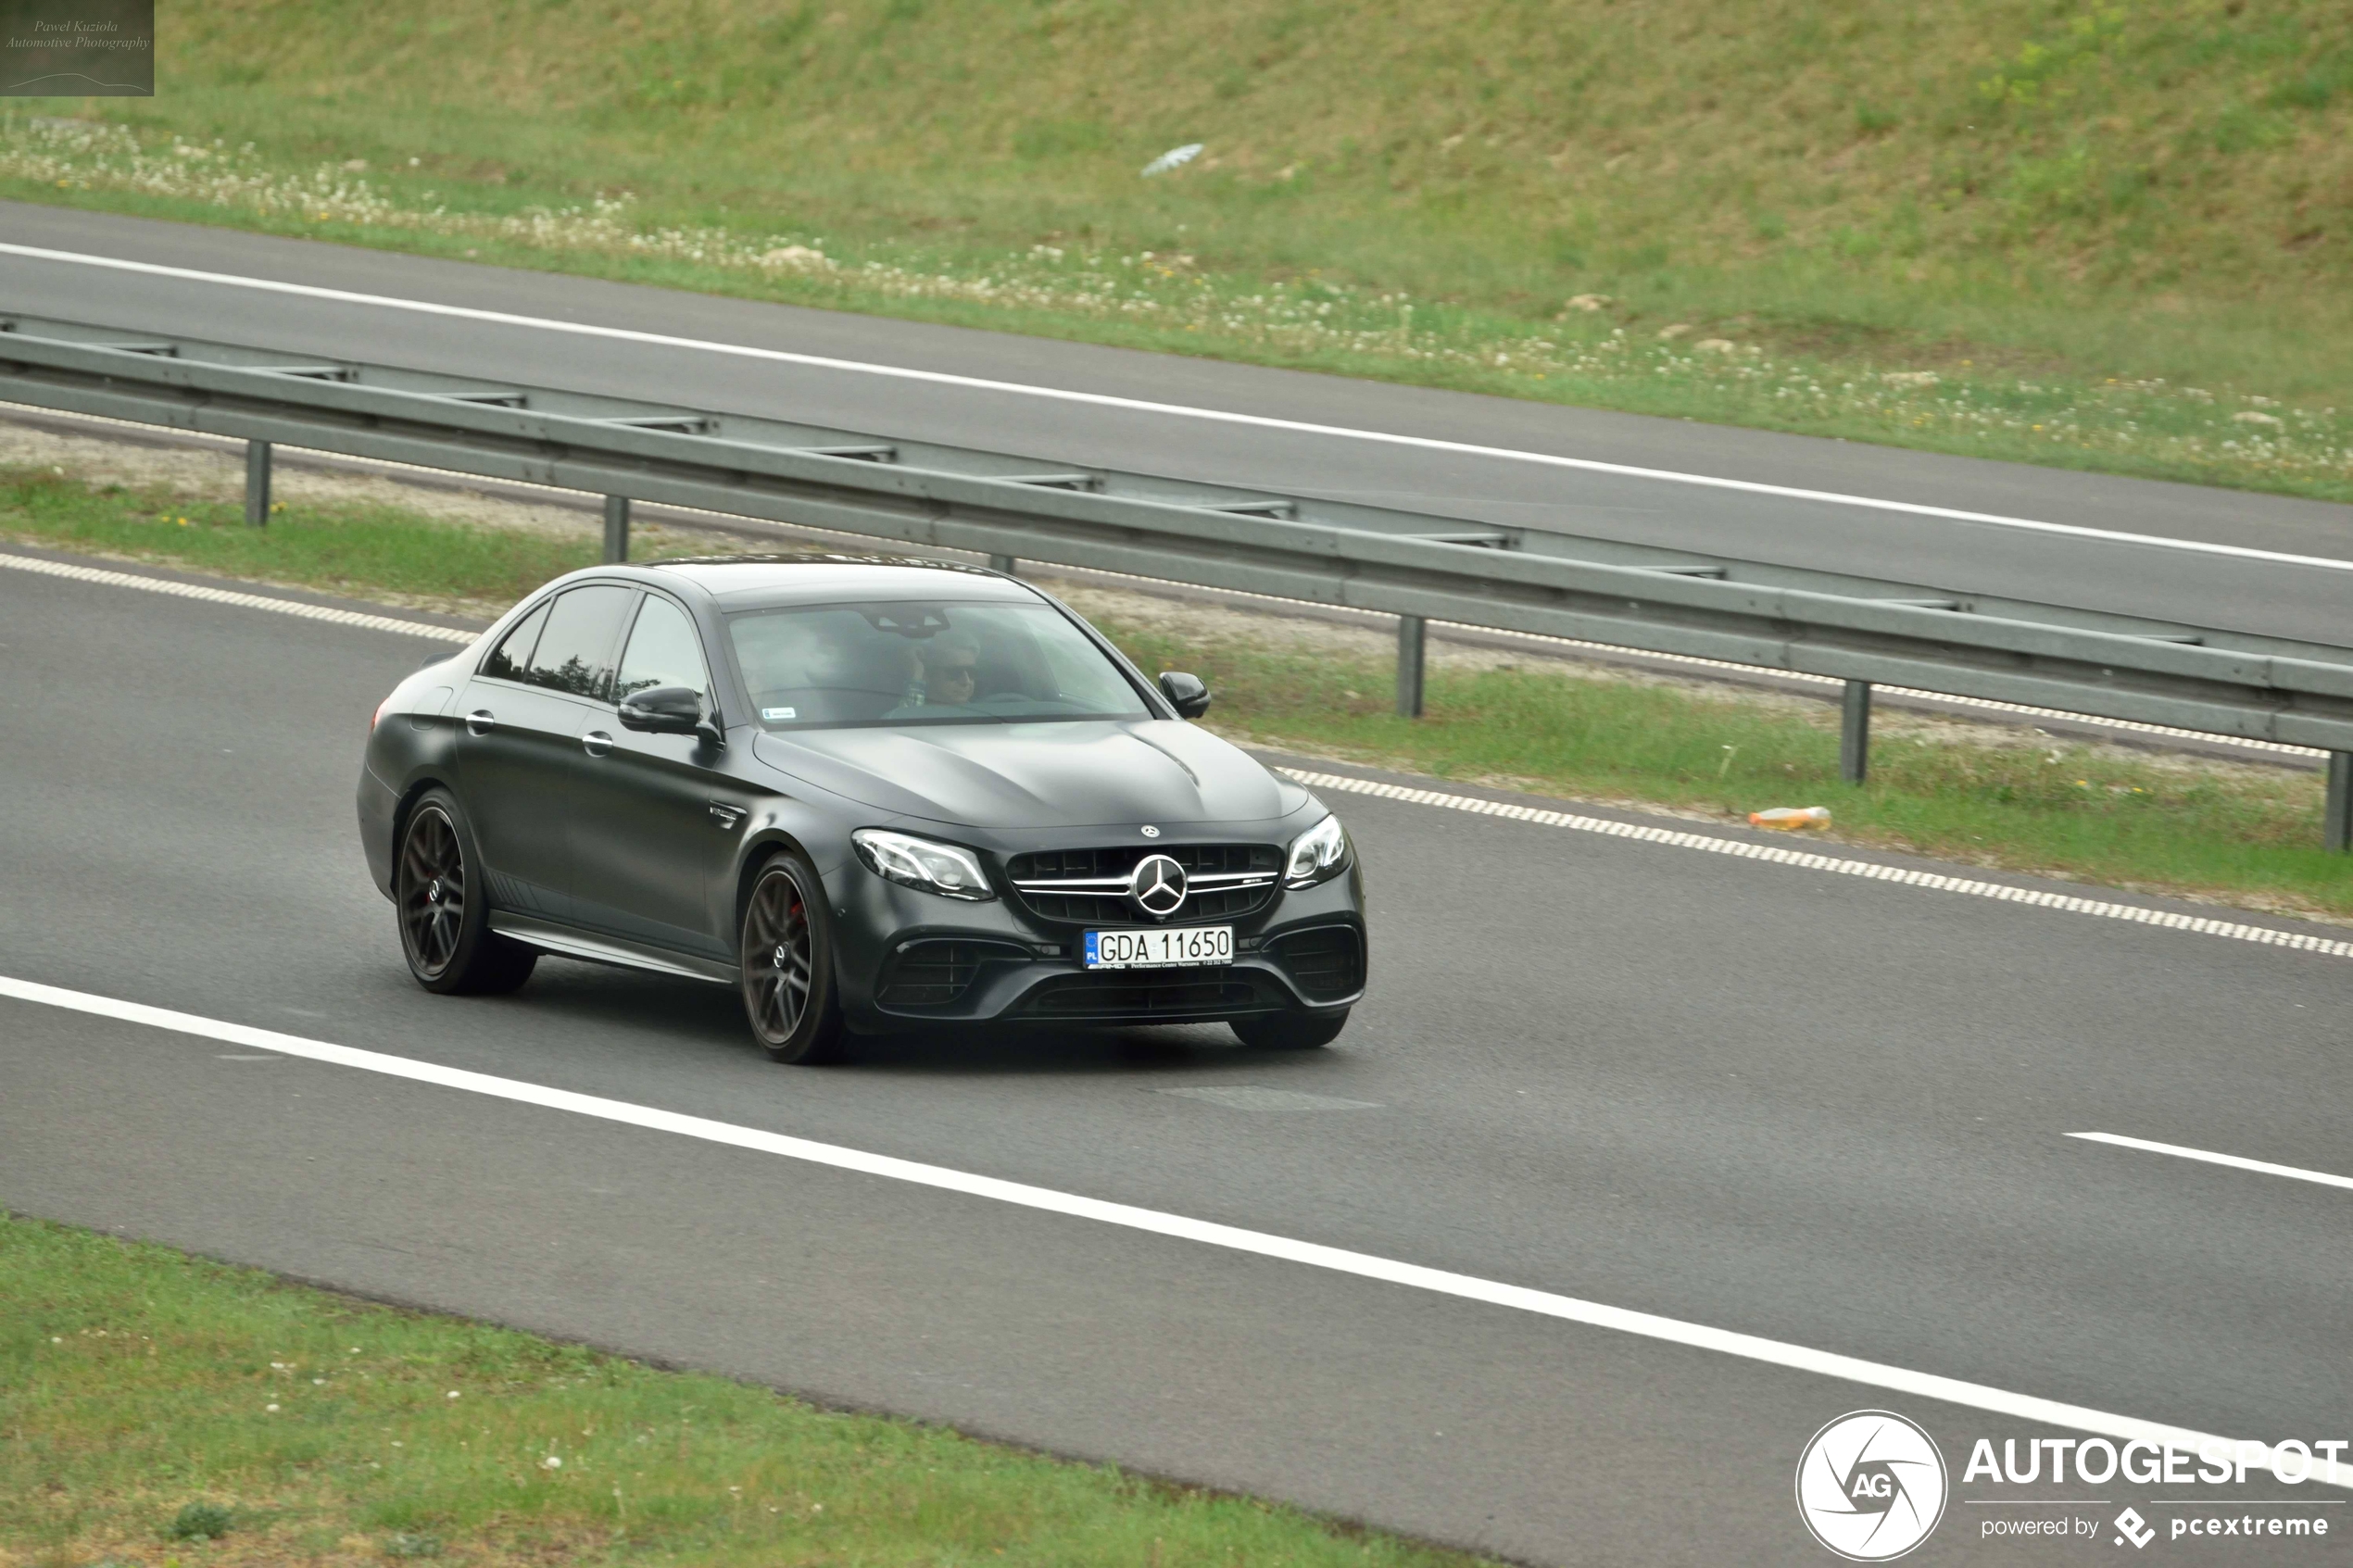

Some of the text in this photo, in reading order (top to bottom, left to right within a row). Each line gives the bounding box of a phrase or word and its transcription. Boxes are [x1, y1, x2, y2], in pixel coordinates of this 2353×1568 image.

[1087, 951, 1097, 960] PL
[1101, 930, 1229, 961] GDA 11650
